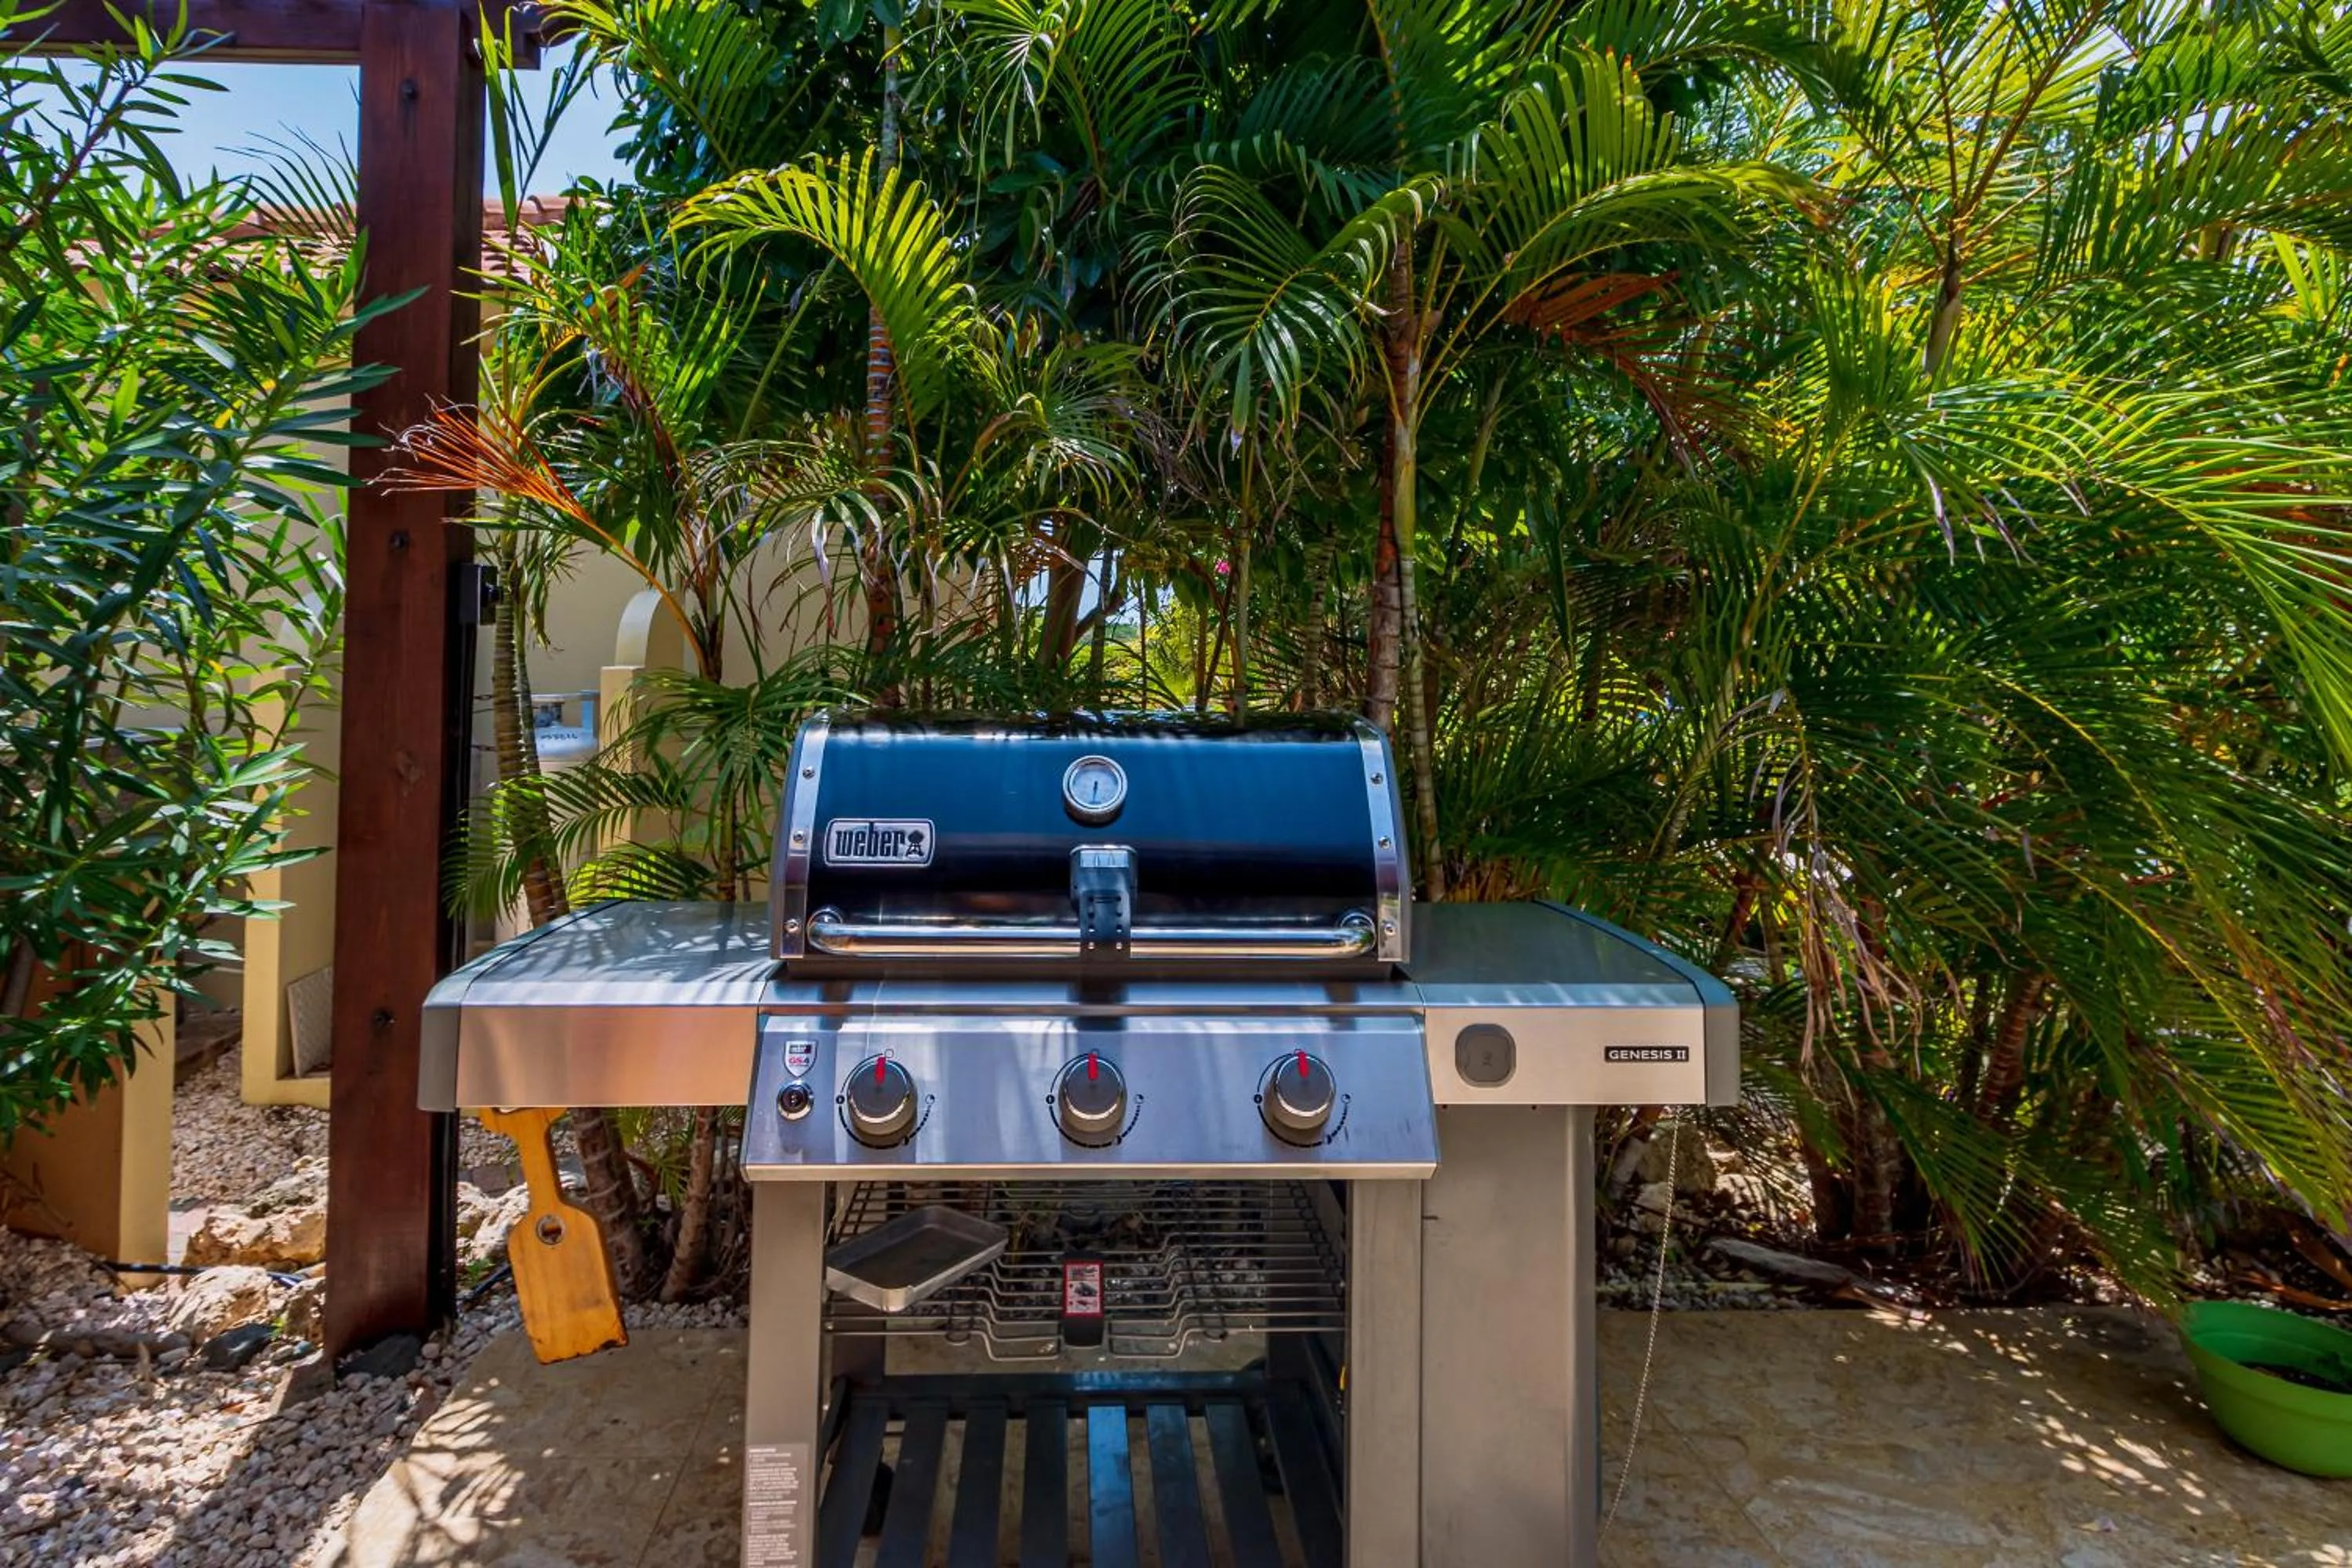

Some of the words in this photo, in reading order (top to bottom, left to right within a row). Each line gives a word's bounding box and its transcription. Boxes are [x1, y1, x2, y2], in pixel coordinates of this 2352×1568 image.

[835, 822, 906, 857] weber
[1608, 1050, 1672, 1060] GENESIS
[1677, 1050, 1686, 1060] II
